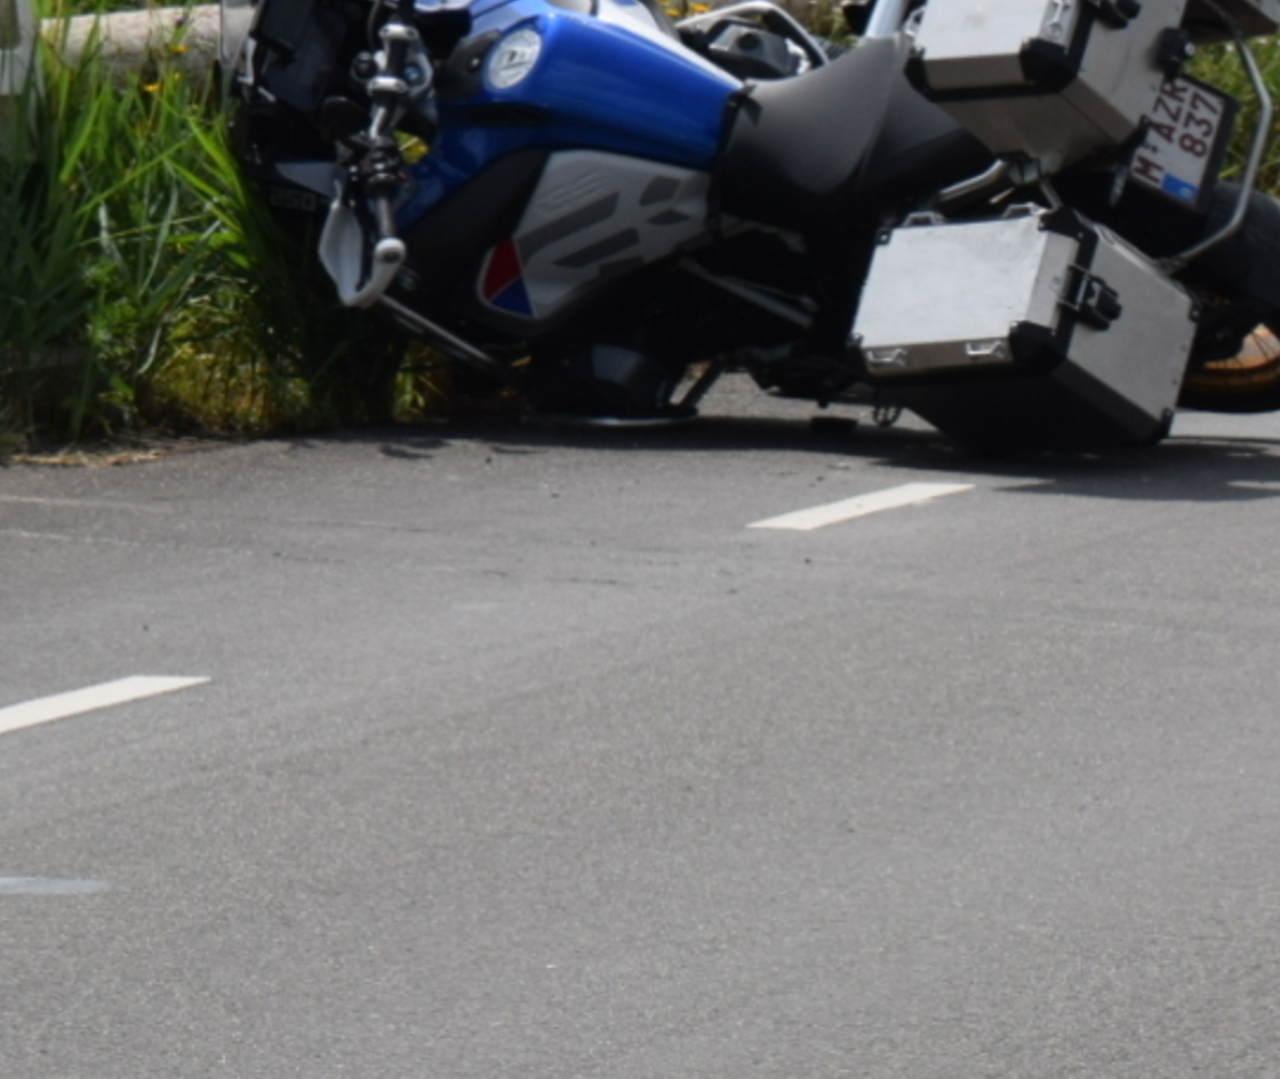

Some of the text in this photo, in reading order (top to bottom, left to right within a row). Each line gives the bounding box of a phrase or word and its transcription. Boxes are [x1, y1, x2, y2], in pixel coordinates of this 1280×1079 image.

[1133, 82, 1188, 184] M AZR
[1179, 93, 1218, 157] 837
